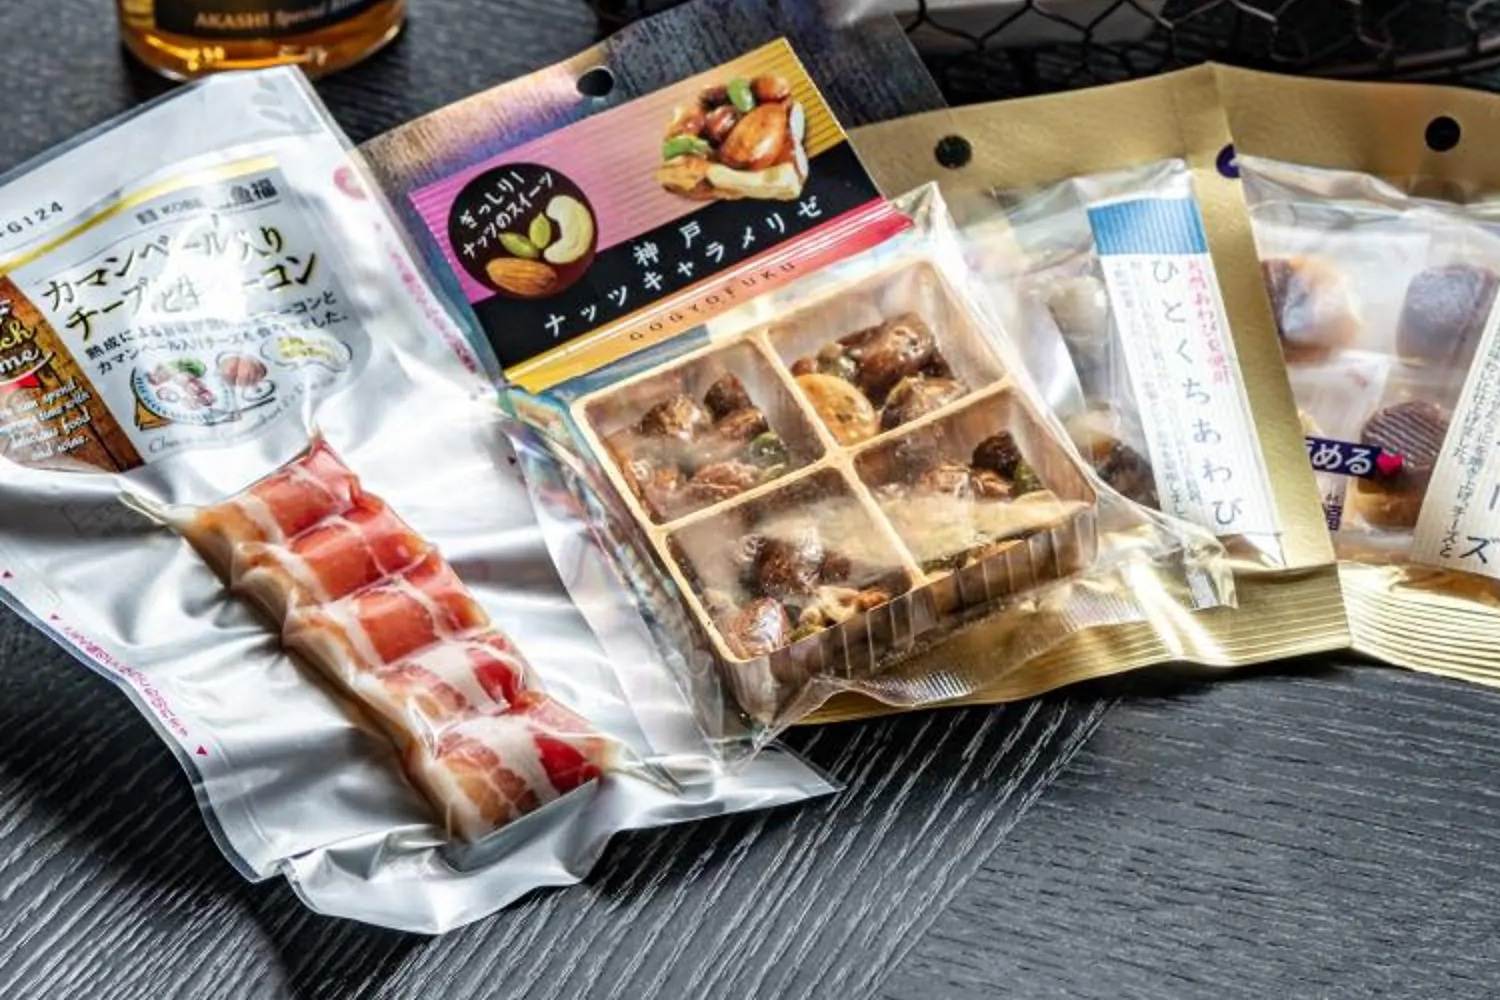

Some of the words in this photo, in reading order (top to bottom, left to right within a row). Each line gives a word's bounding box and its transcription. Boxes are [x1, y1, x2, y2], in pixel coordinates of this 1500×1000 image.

[195, 11, 270, 28] AKASHI
[461, 172, 555, 260] ナッツのスイーツ
[633, 222, 701, 268] 神戸
[544, 197, 824, 337] ナッツキャラメリゼ
[629, 261, 796, 342] GOGYOFUKU
[1151, 259, 1243, 525] ひとくちあわび
[1305, 440, 1373, 474] める
